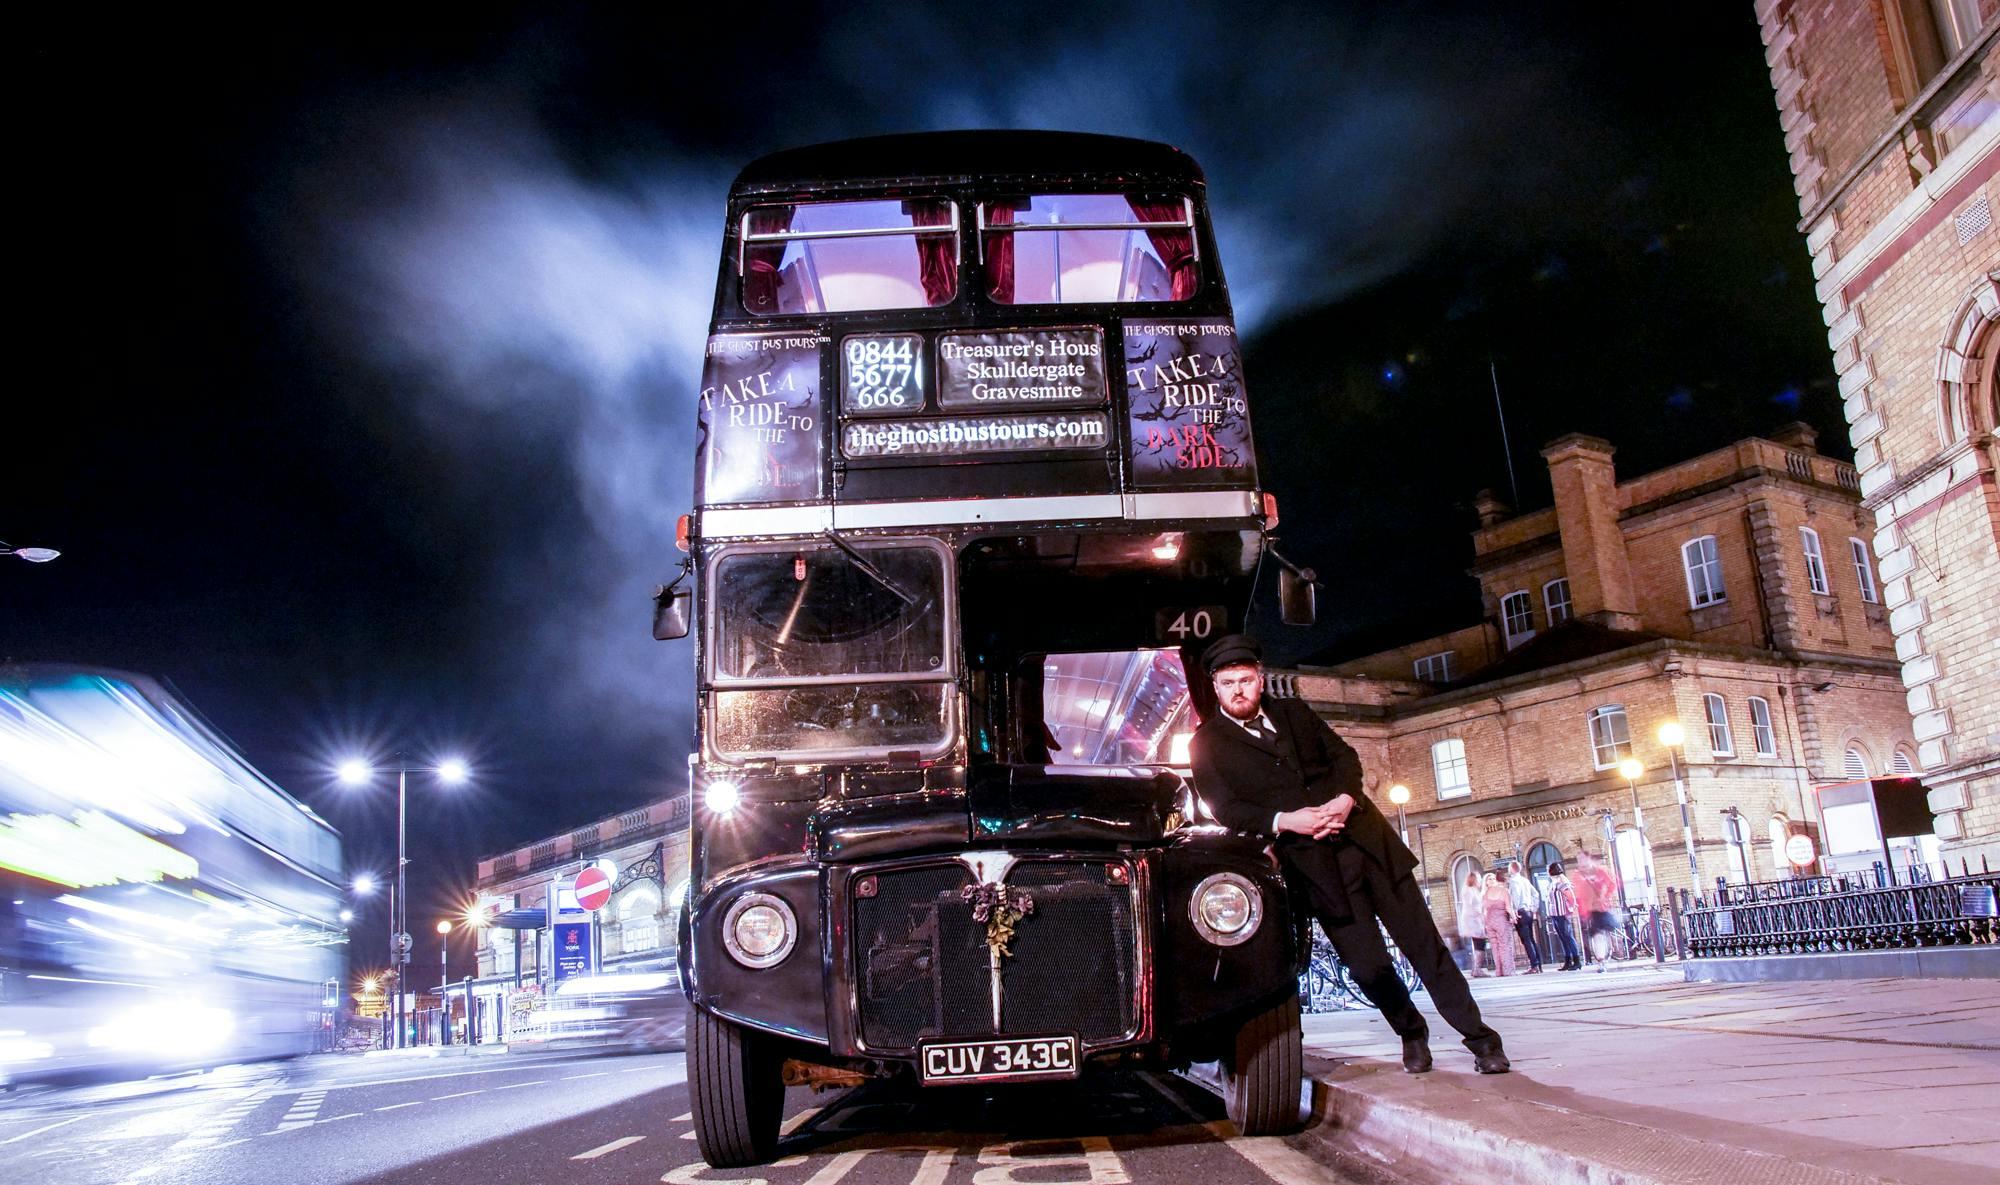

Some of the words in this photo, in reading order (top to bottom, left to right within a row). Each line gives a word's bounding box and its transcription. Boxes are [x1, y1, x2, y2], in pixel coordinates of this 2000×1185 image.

[1124, 325, 1142, 336] THE
[1144, 325, 1176, 336] GHOST
[1178, 325, 1197, 336] BUS
[762, 338, 782, 350] BUS
[849, 341, 913, 365] 0844
[942, 340, 1045, 359] Treasurer's
[1049, 339, 1101, 357] Hous
[849, 364, 912, 387] 5677
[967, 361, 1086, 381] Skulldergate
[1127, 354, 1208, 391] TAKE
[1210, 355, 1227, 374] A
[700, 371, 776, 411] TAKE
[779, 372, 796, 391] A
[858, 386, 905, 408] 666
[972, 382, 1082, 400] Gravesmire
[1164, 383, 1222, 407] RIDE
[1222, 396, 1246, 413] TO
[729, 401, 788, 427] RIDE
[788, 415, 813, 431] TO
[1189, 408, 1223, 424] THE
[754, 428, 786, 443] THE
[851, 420, 1104, 450] theghostbustours.com
[1147, 424, 1220, 449] DARK
[1167, 611, 1212, 639] 40
[1501, 815, 1535, 831] DUKE
[1550, 806, 1588, 820] YORK
[927, 1046, 985, 1075] CUV
[993, 1042, 1070, 1071] 343C
